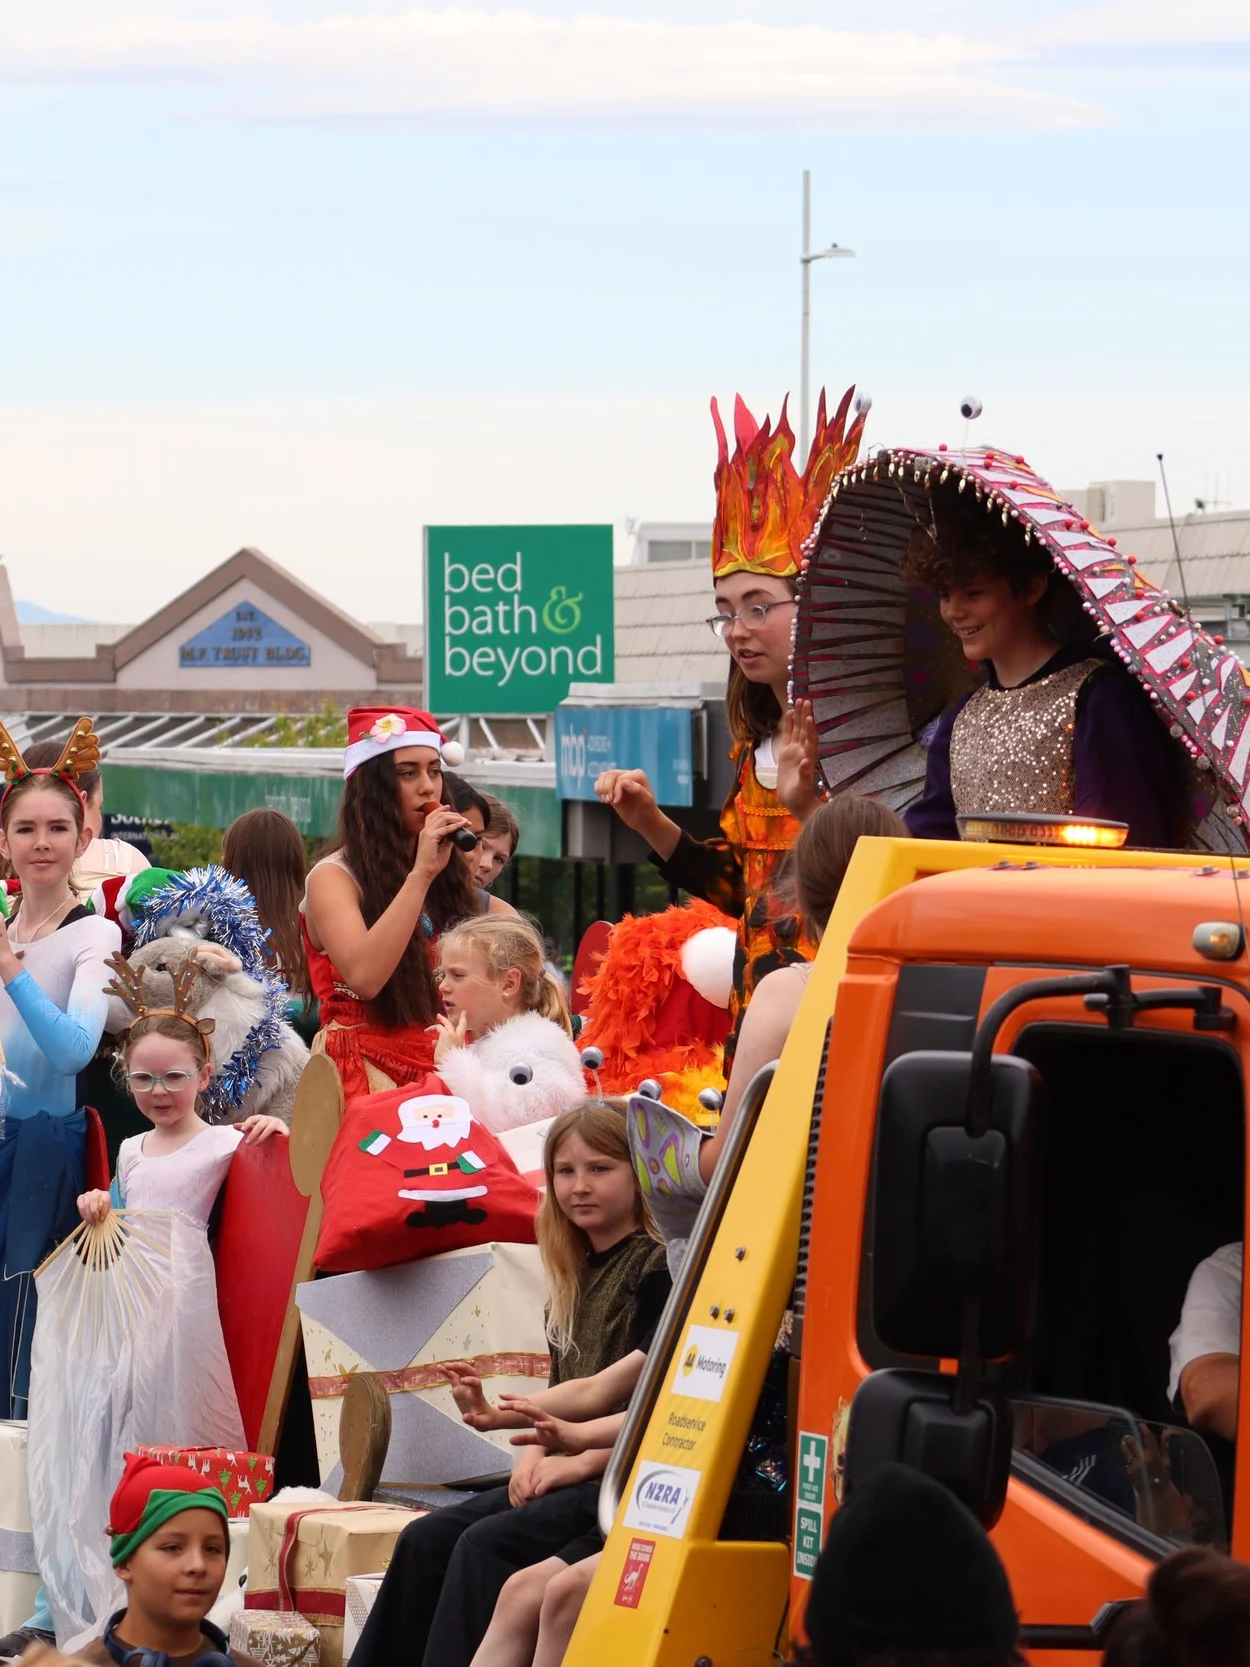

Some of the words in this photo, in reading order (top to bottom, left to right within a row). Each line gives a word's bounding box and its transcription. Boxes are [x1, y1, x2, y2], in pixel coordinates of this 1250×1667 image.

[444, 551, 522, 593] bed
[445, 593, 537, 634] bath
[542, 585, 583, 634] &
[212, 646, 259, 661] TRUST
[444, 634, 602, 687] beyond
[696, 1355, 727, 1379] Motoring
[668, 1411, 707, 1432] Roadservice
[661, 1432, 697, 1451] Contractor
[644, 1481, 682, 1506] NZRA
[800, 1516, 818, 1533] SPILL
[802, 1536, 814, 1549] KIT
[797, 1551, 817, 1568] INSID
